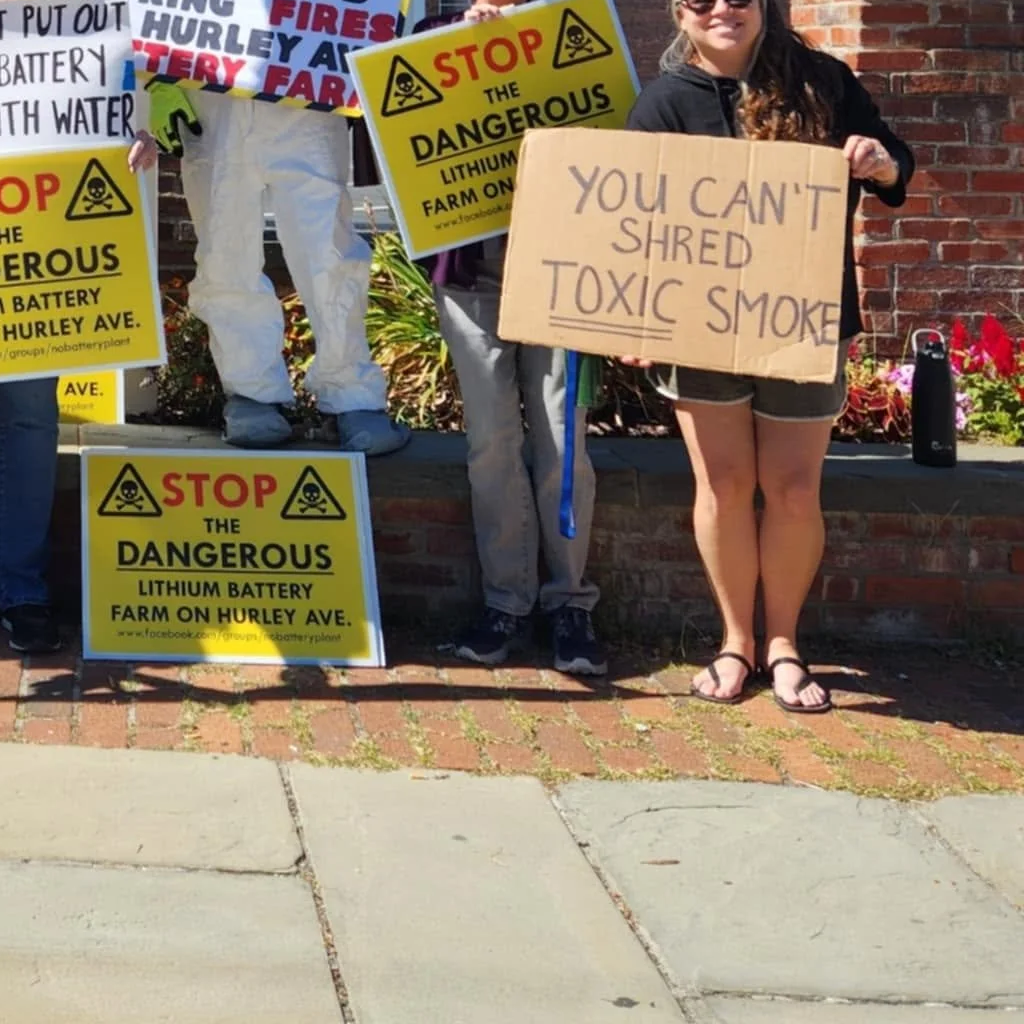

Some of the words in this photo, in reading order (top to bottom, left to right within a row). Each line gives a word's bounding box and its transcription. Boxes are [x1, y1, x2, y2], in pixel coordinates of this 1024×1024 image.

[23, 4, 67, 36] PUT
[73, 1, 126, 34] OUT
[140, 10, 303, 63] HURLEY
[132, 39, 247, 86] TERY
[262, 64, 360, 109] FAR
[433, 28, 543, 89] STOP
[484, 82, 520, 105] THE
[52, 93, 136, 139] WATER
[410, 83, 611, 161] DANGEROUS
[440, 149, 517, 185] LITHIUM
[422, 187, 478, 217] FARM
[483, 177, 515, 199] ON
[568, 165, 667, 214] YOU
[689, 176, 841, 231] CAN'T
[611, 216, 753, 269] SHRED
[13, 288, 101, 313] BATTERY
[542, 259, 684, 325] TOXIC
[706, 285, 840, 346] SMOKE
[2, 316, 86, 341] HURLEY
[93, 311, 140, 332] AVE.
[64, 382, 104, 396] AVE.
[162, 472, 278, 508] STOP
[204, 518, 240, 534] THE
[117, 541, 332, 570] DANGEROUS
[139, 580, 220, 597] LITHIUM
[228, 582, 313, 600] BATTERY
[111, 605, 169, 622] FARM
[177, 607, 210, 624] ON
[217, 608, 296, 626] HURLEY
[305, 609, 352, 627] AVE.
